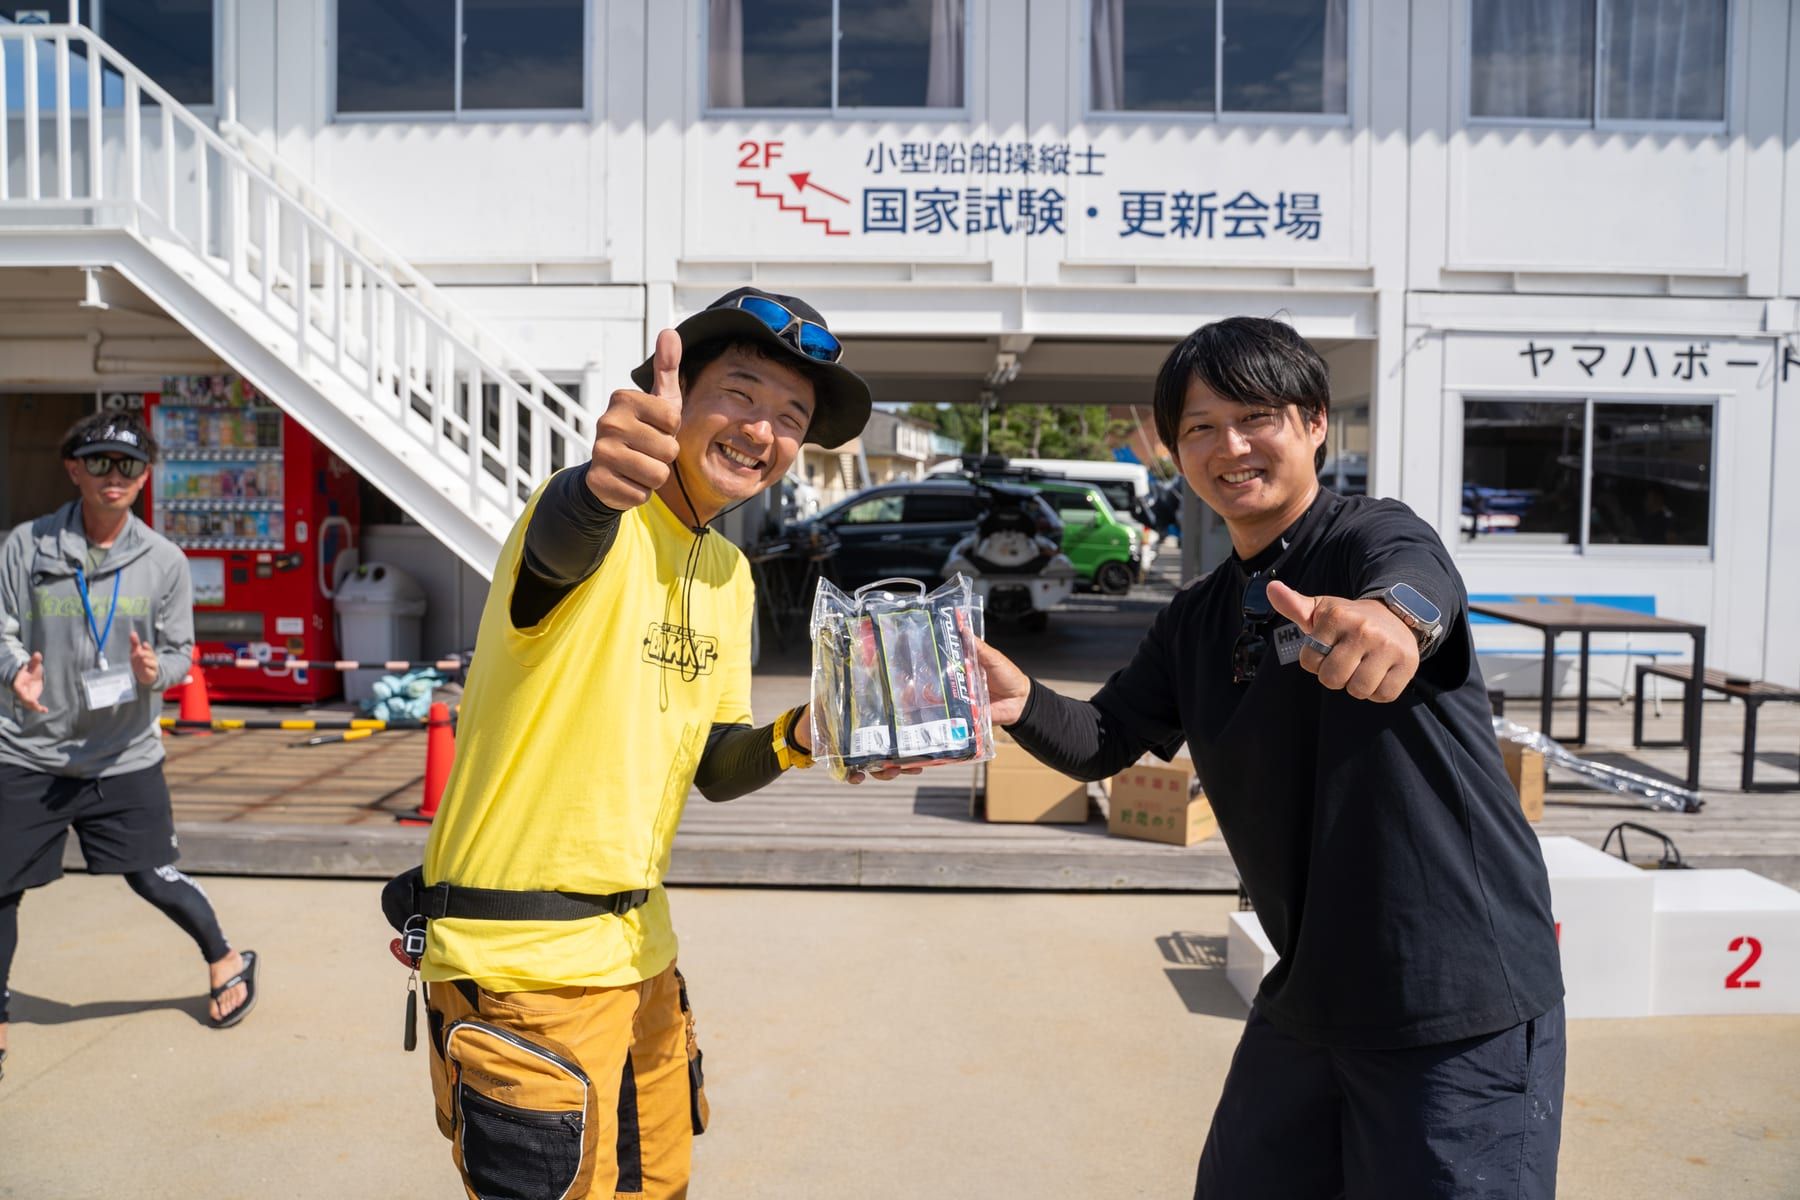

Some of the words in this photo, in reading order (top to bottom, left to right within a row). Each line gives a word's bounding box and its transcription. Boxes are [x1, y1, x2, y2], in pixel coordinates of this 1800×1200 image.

[738, 141, 784, 169] 2F
[865, 142, 1105, 176] 小型船舶操縦士
[862, 188, 1322, 240] 国家試験・更新会場
[1725, 936, 1762, 989] 2
